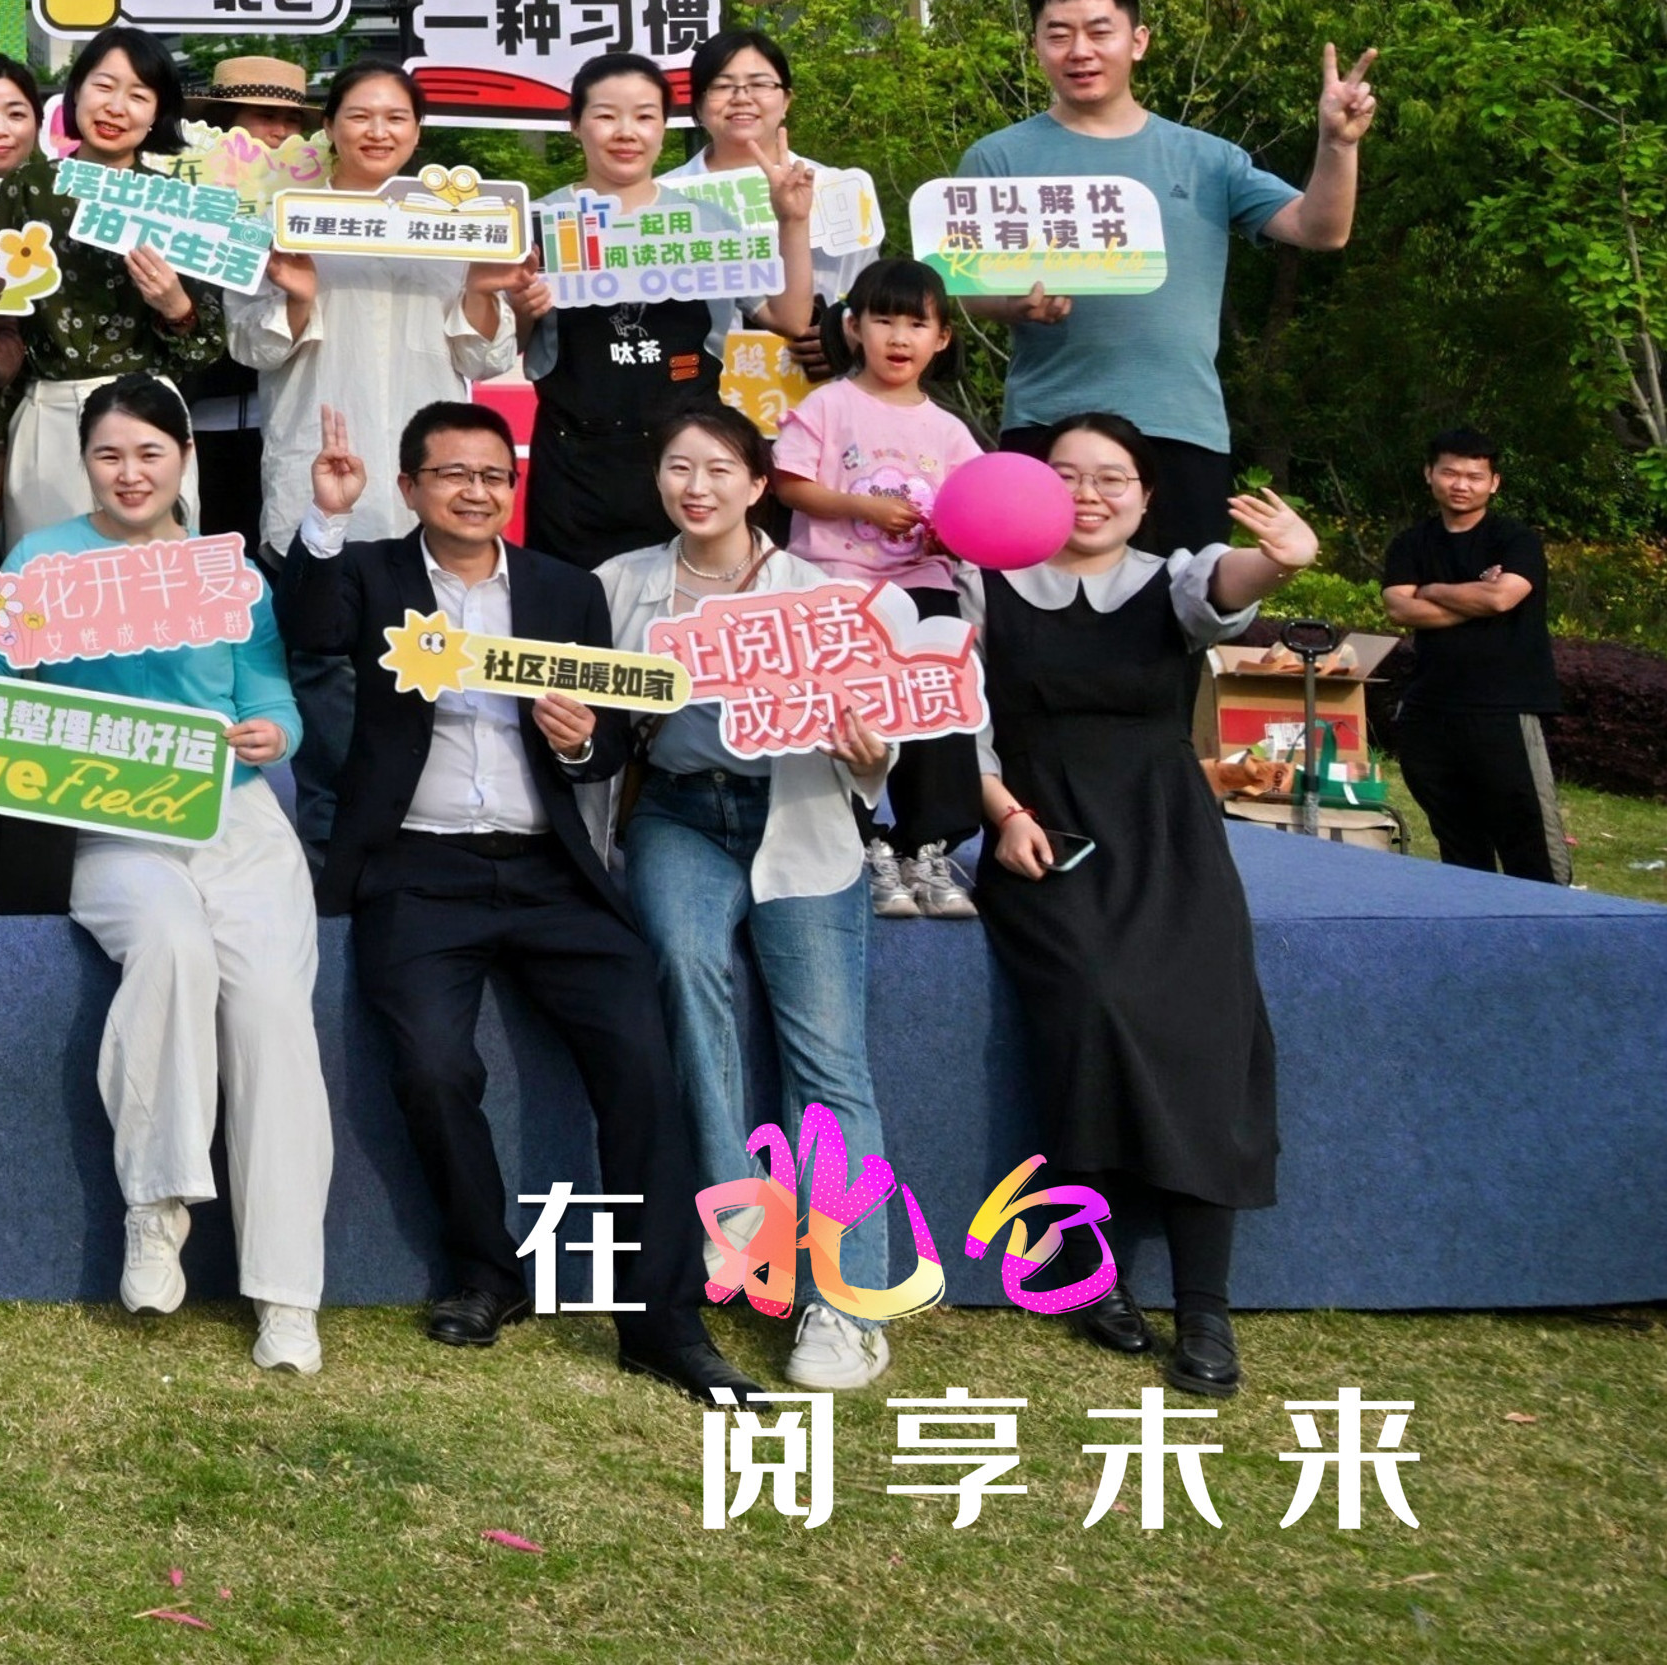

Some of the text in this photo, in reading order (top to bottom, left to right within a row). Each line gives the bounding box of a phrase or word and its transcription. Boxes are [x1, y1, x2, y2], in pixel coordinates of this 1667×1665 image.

[54, 161, 239, 226] 摆出热爱
[943, 184, 1125, 215] 何以解忧
[77, 202, 261, 287] 拍下生活
[287, 214, 510, 245] 布里生花 染出幸福
[612, 211, 694, 237] 一起用
[946, 219, 1129, 250] 唯有读书
[604, 236, 772, 270] 阅读改变生活
[639, 262, 778, 296] OCEEN
[29, 541, 244, 623] 花开半夏
[44, 609, 243, 656] 女性成长社群
[660, 595, 875, 684] 让阅读
[482, 647, 676, 703] 社区温暖如家
[726, 664, 965, 744] 成为习惯
